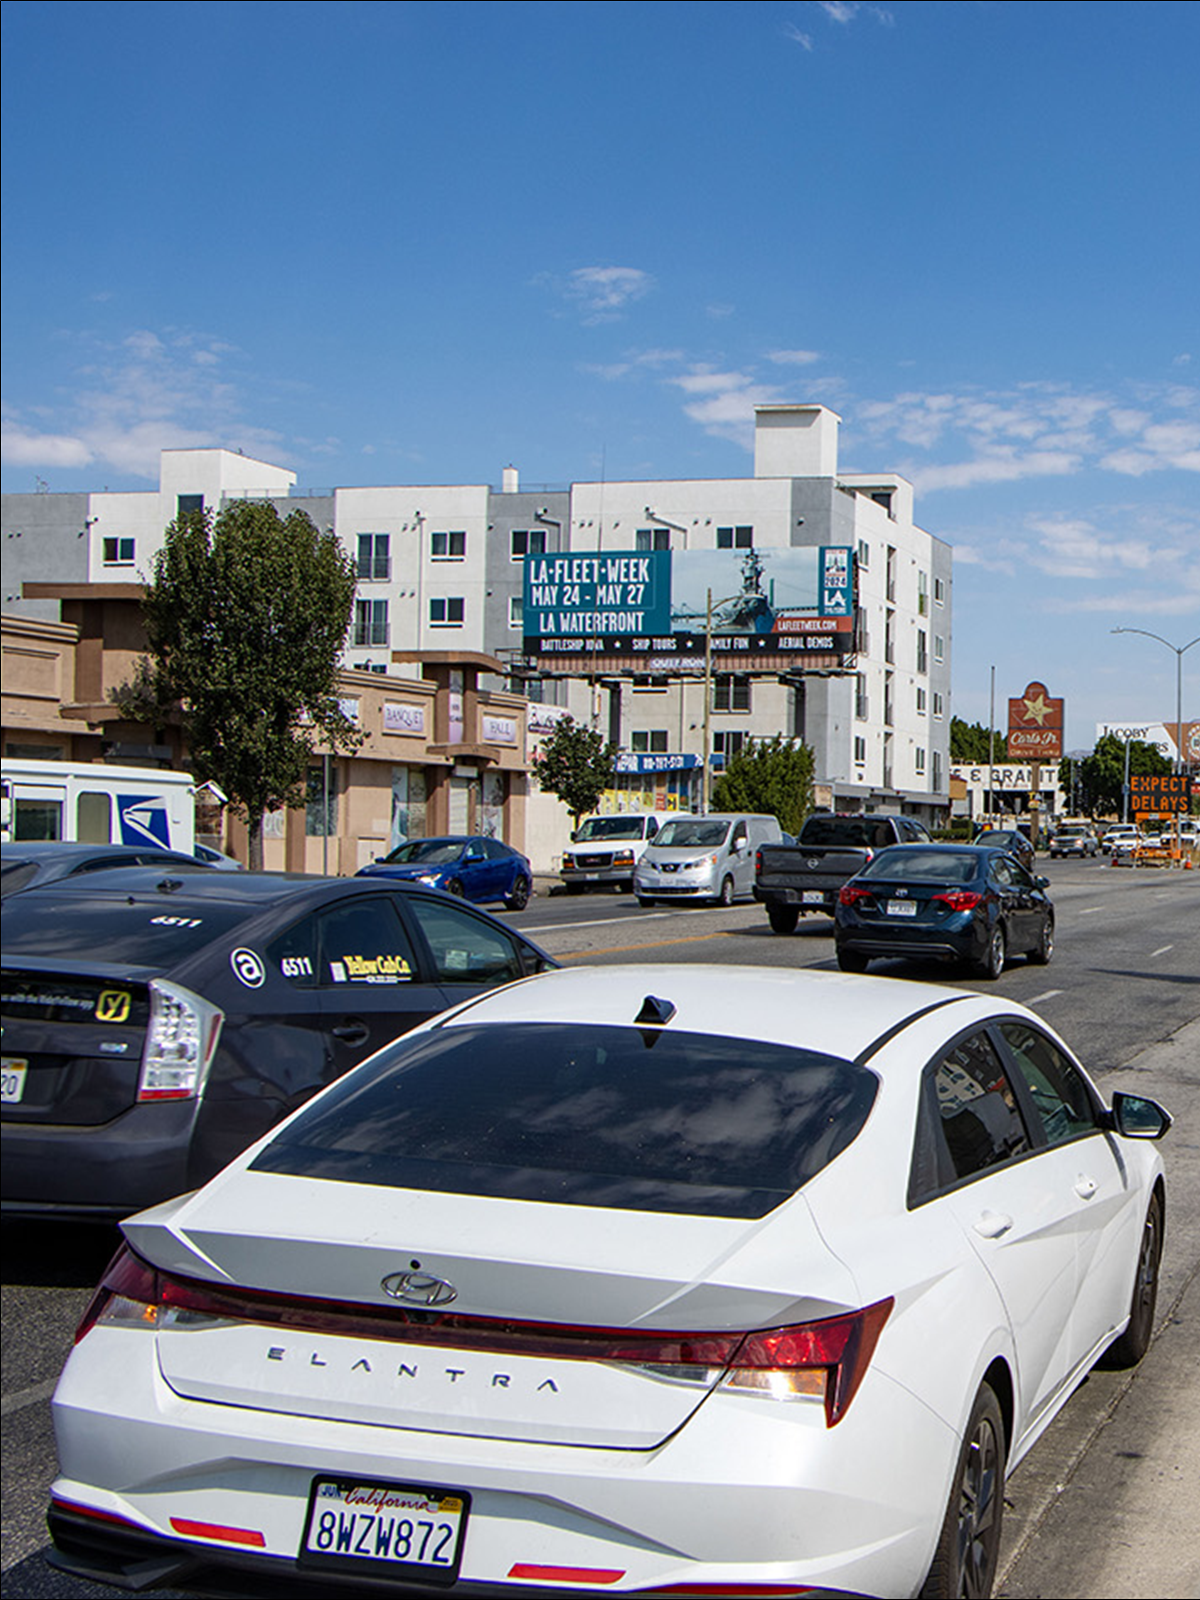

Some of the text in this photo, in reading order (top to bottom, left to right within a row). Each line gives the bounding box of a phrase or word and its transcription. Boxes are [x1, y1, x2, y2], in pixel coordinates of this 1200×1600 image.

[532, 585, 558, 606] MAY
[563, 584, 580, 606] 24
[597, 584, 622, 605] MAY
[627, 583, 645, 605] 27
[540, 611, 645, 633] LA WATERFRONT
[540, 639, 584, 651] BATTLESHIP
[631, 638, 678, 651] SHIP TOURS
[709, 637, 750, 650] AMILY FUN
[778, 636, 835, 650] AERIAL DEMOS
[386, 708, 425, 727] BANQUET
[970, 768, 982, 782] &
[1130, 775, 1189, 793] EXPECT
[1131, 795, 1189, 812] DELAYS
[150, 915, 202, 928] 6511
[281, 956, 313, 977] 6511
[343, 955, 378, 975] Yellow
[377, 955, 396, 974] Cab
[267, 1346, 559, 1393] ELANTRA
[343, 1486, 439, 1514] California
[315, 1510, 454, 1565] 8WZW872
